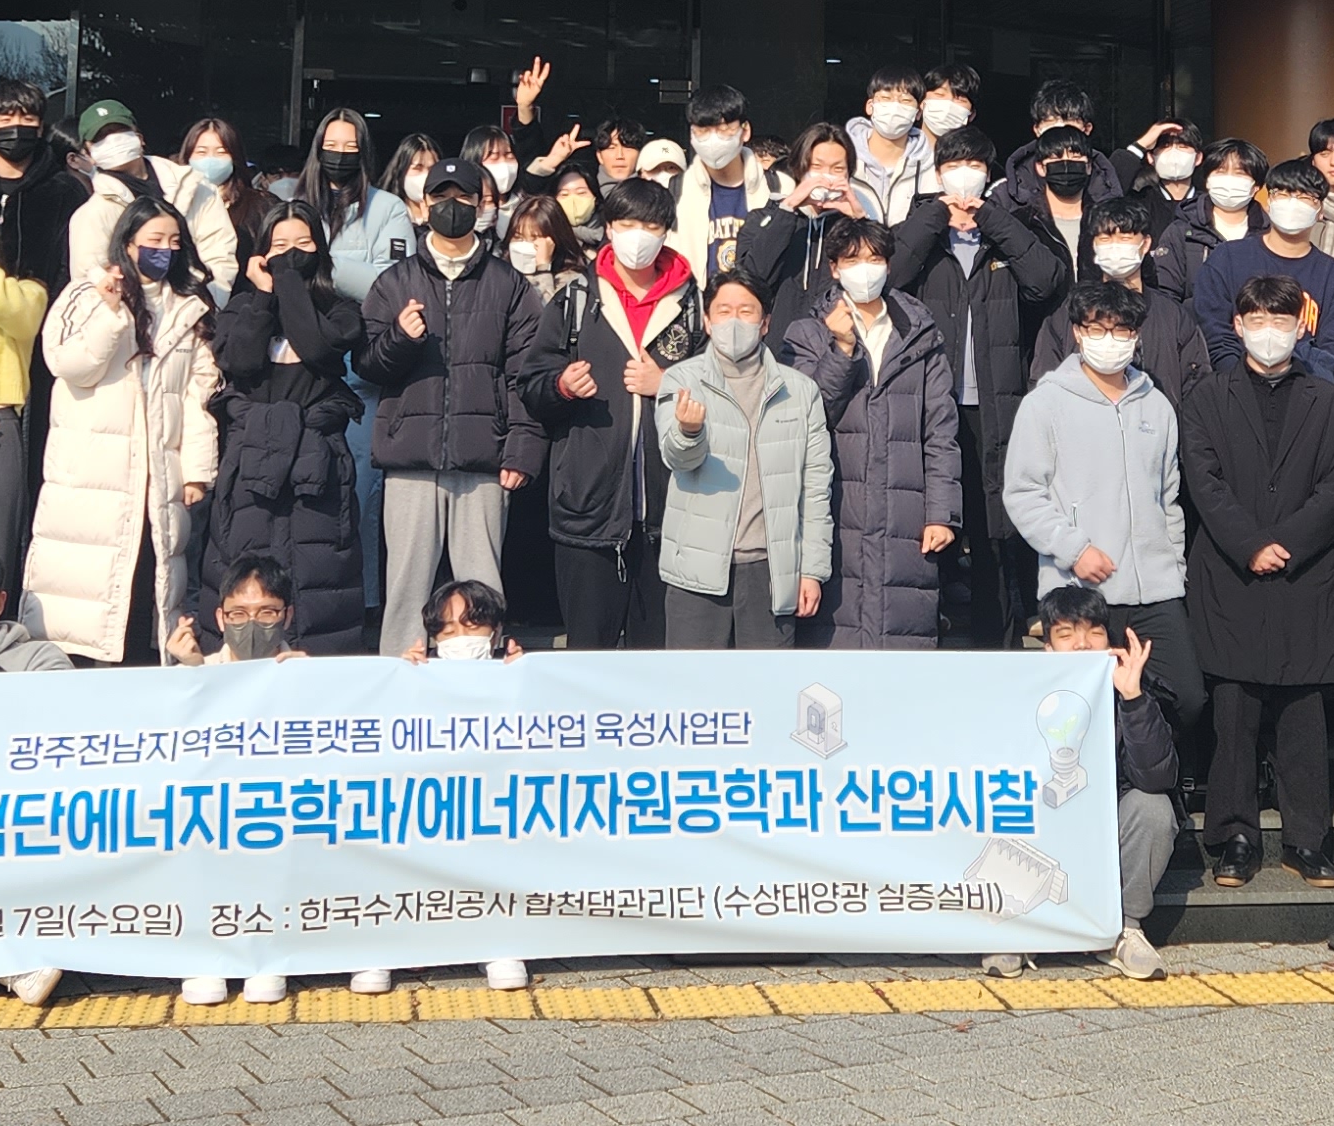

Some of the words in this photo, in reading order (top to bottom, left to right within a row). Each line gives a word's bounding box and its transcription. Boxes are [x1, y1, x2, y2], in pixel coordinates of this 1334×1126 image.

[9, 718, 381, 771] 광주전남지역혁신플랫폼
[392, 712, 588, 752] 에너지신산업
[594, 711, 752, 747] 육성사업단
[836, 768, 1038, 835] 산업시찰
[15, 903, 183, 938] 7일(수요일)
[210, 905, 277, 938] 장소
[300, 889, 516, 931] 한국수자원공사
[525, 888, 705, 920] 합천댐관리단
[713, 883, 869, 917] (수상태양광
[878, 883, 1005, 915] 실증설비)
